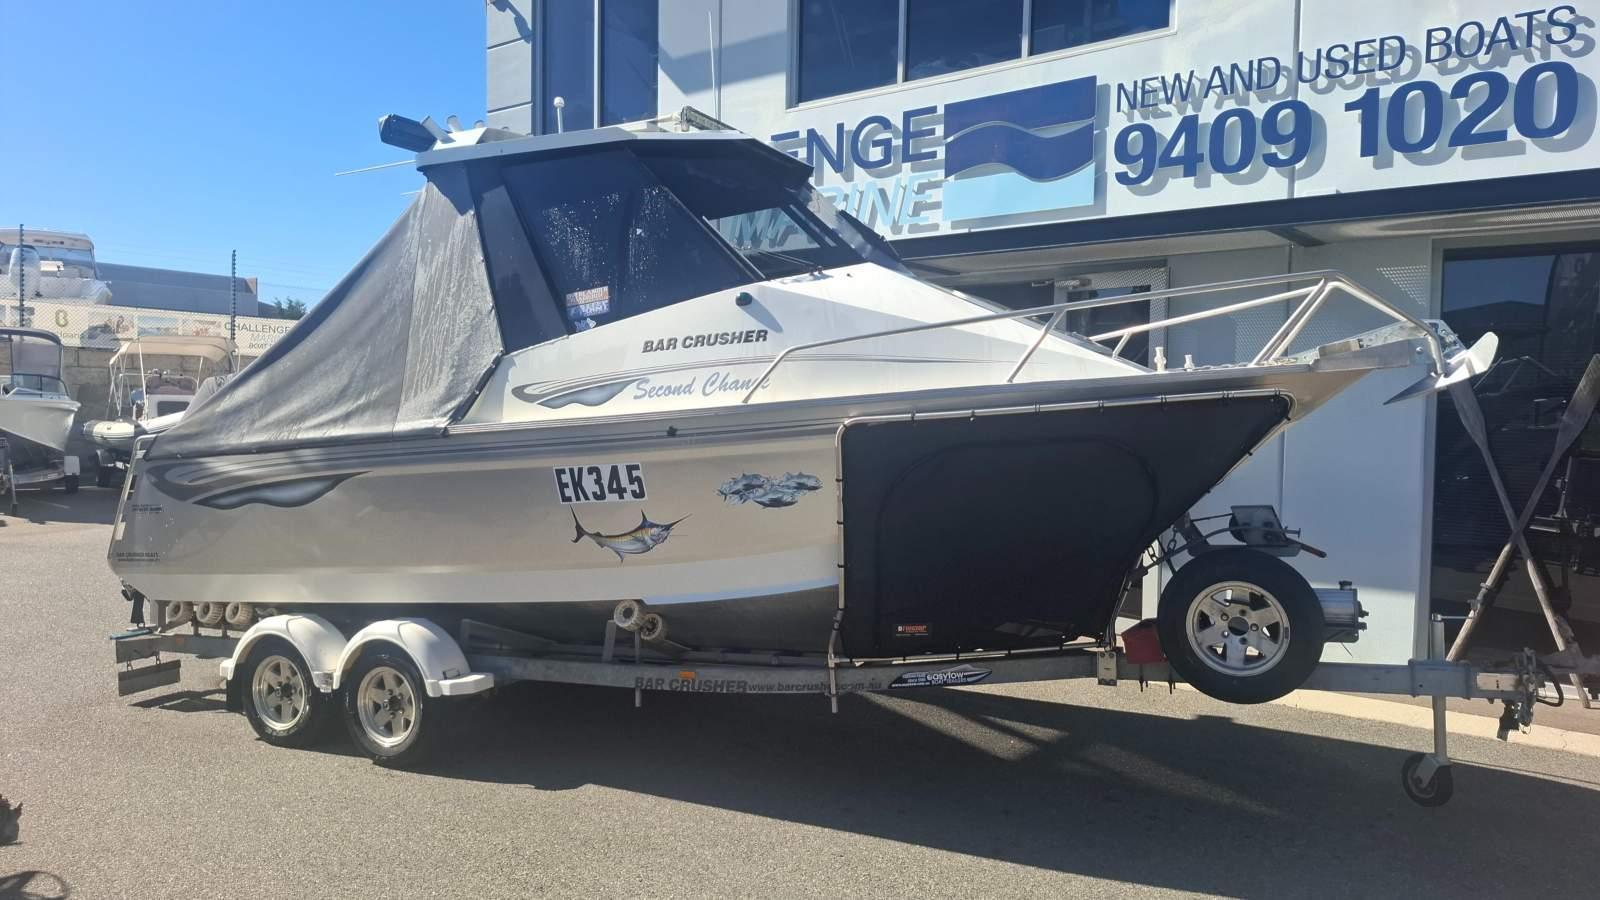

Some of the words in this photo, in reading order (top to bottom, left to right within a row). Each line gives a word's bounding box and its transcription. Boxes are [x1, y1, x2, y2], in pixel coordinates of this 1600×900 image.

[1116, 70, 1195, 113] NEW
[1203, 56, 1281, 99] AND
[1298, 35, 1406, 84] USED
[1425, 5, 1577, 64] BOATS
[1114, 99, 1313, 186] 9409
[1344, 61, 1579, 158] 1020
[641, 337, 678, 353] BAR
[682, 329, 769, 349] CRUSHER
[633, 376, 697, 400] Second
[555, 464, 646, 502] EK345
[634, 676, 665, 690] BAR
[668, 676, 748, 693] CRUSHER
[748, 679, 882, 692] www.barcrush.com.au
